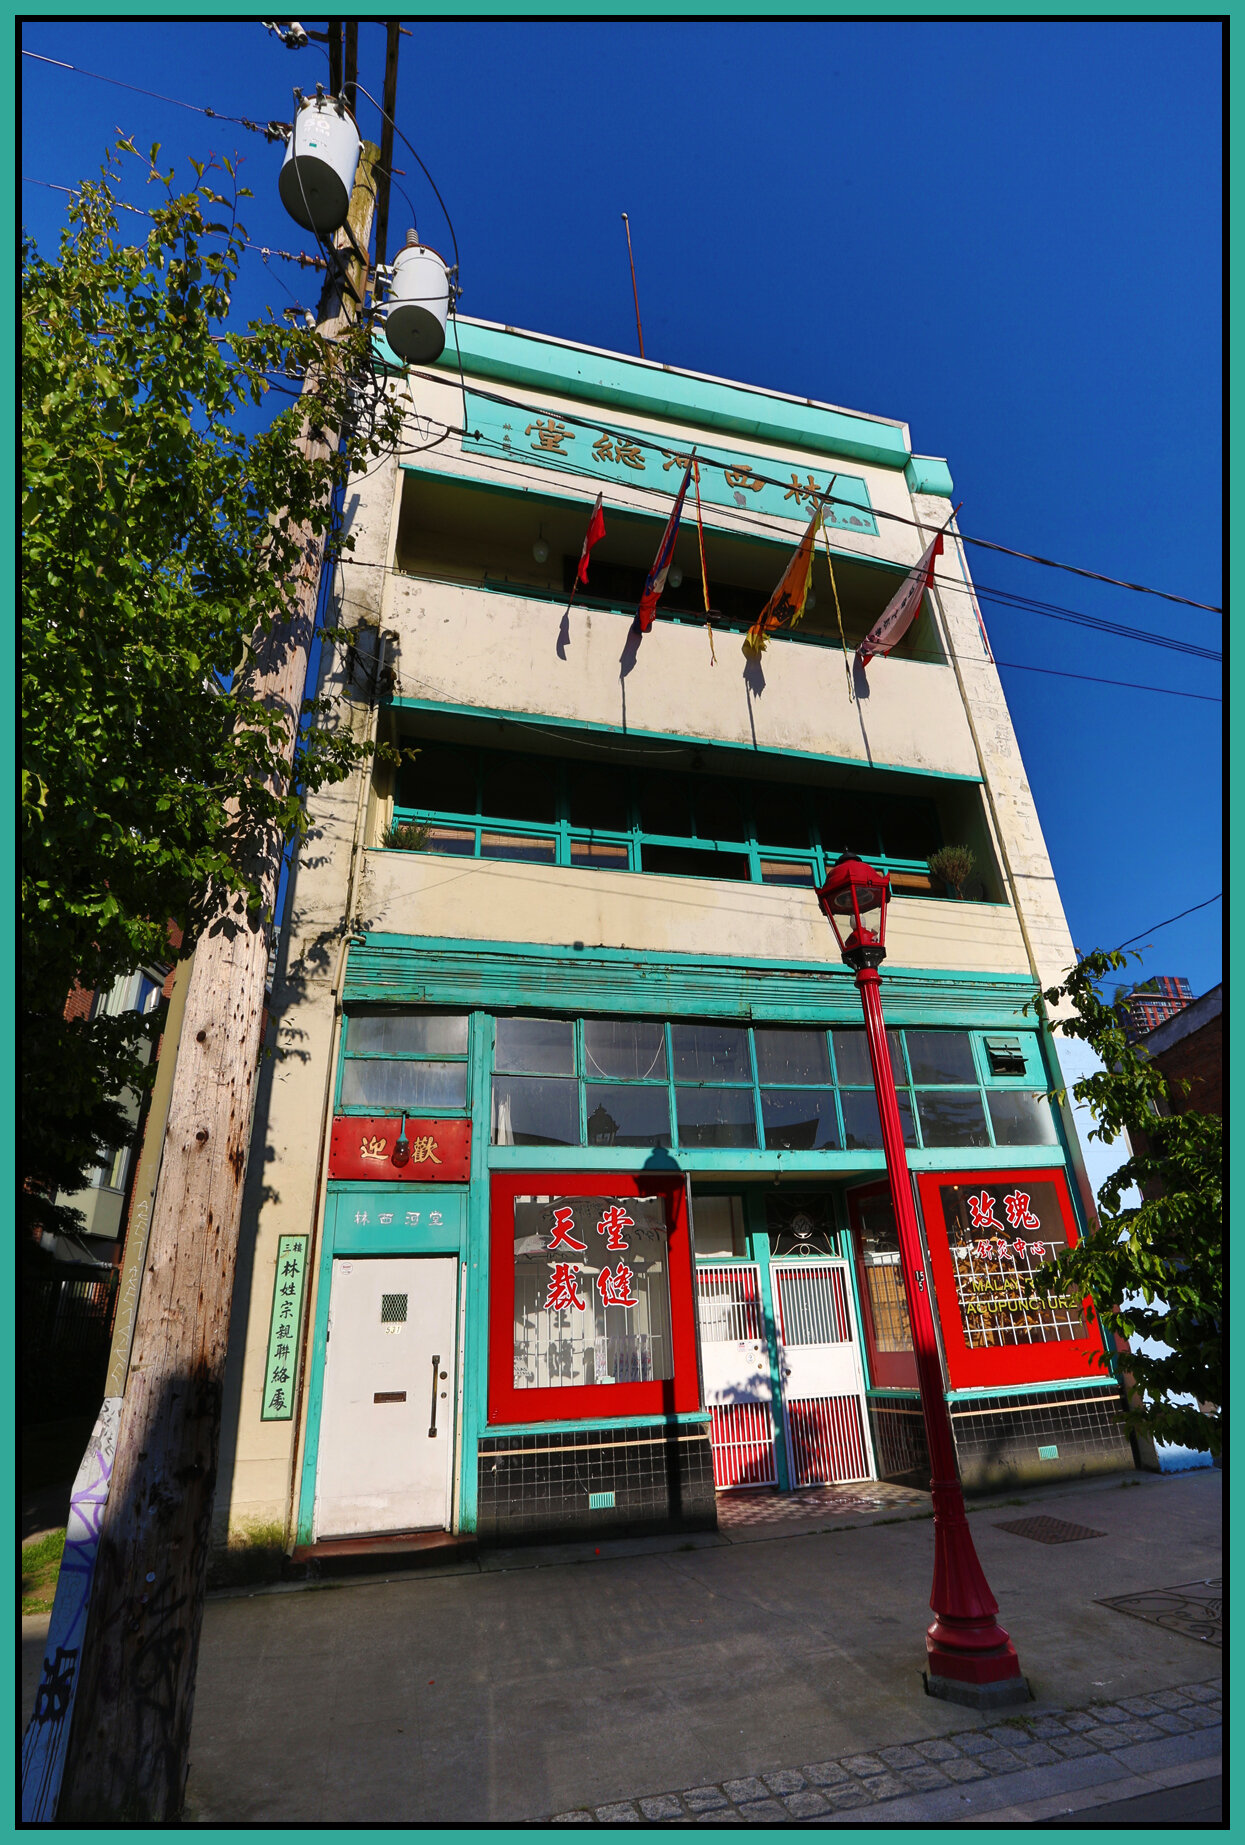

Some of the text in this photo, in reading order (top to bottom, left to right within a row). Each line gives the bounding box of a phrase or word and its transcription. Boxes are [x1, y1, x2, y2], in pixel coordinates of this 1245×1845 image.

[353, 1210, 444, 1226] 林西河堂
[967, 1189, 1041, 1231] 玫瑰
[546, 1205, 635, 1251] 天堂
[385, 1326, 402, 1334] 531
